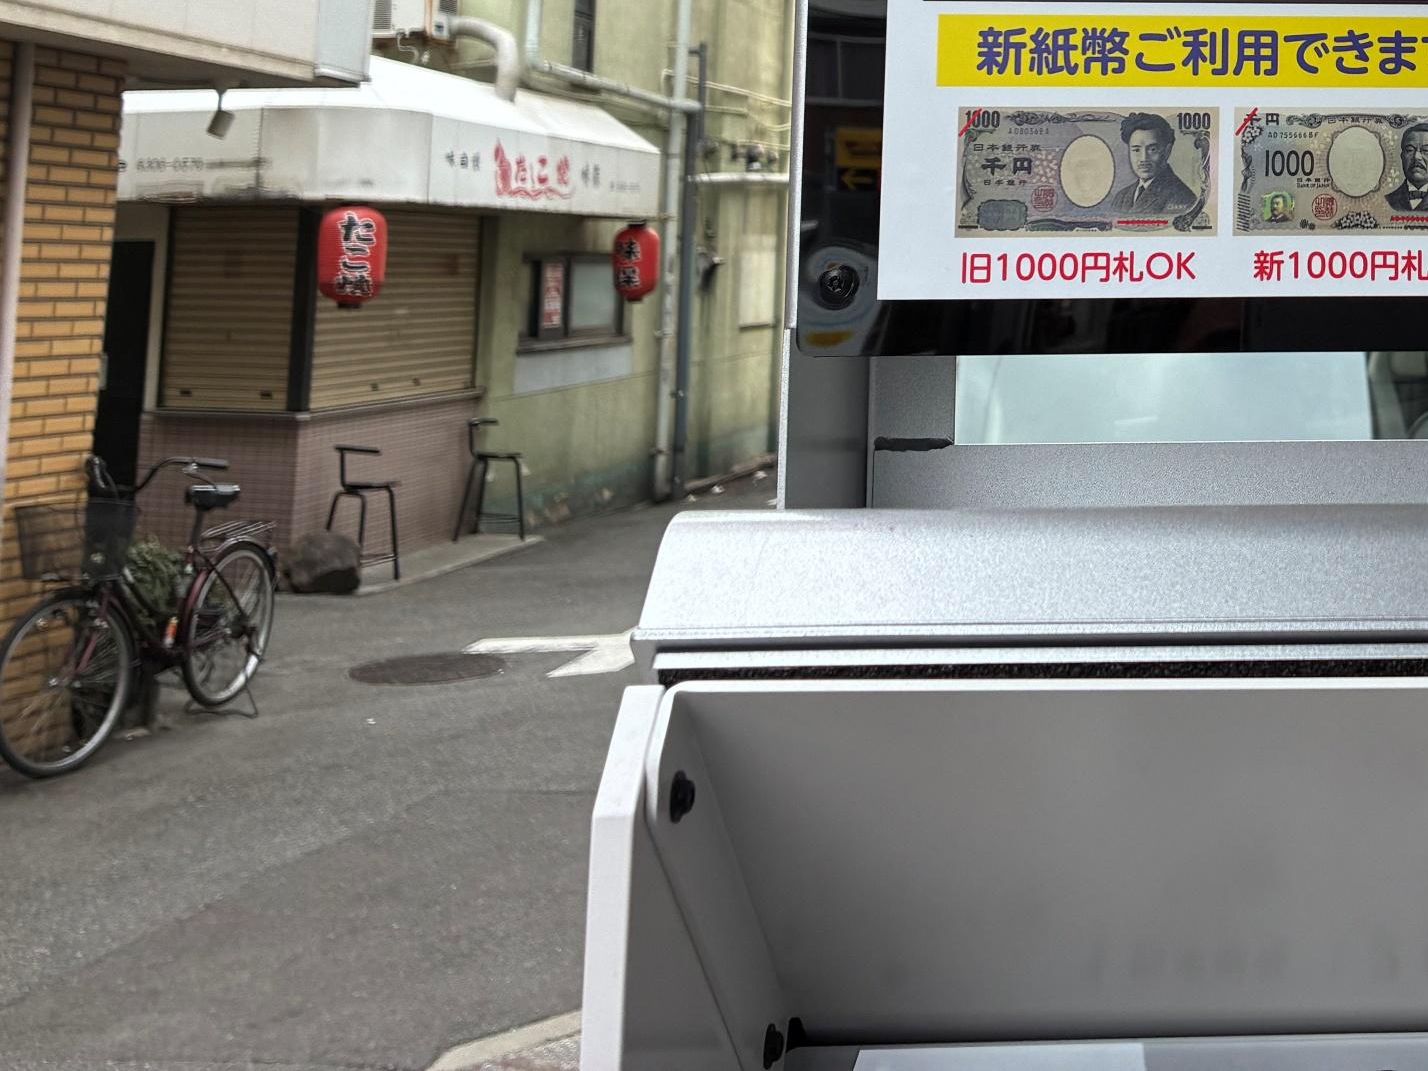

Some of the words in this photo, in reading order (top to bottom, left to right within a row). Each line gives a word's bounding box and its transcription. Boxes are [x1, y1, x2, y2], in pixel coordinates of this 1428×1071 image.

[965, 110, 1000, 128] 1000
[1177, 112, 1211, 129] 1000
[981, 157, 1032, 176] 千円
[1264, 150, 1315, 177] 1000
[962, 252, 1196, 283] 旧1000円札OK
